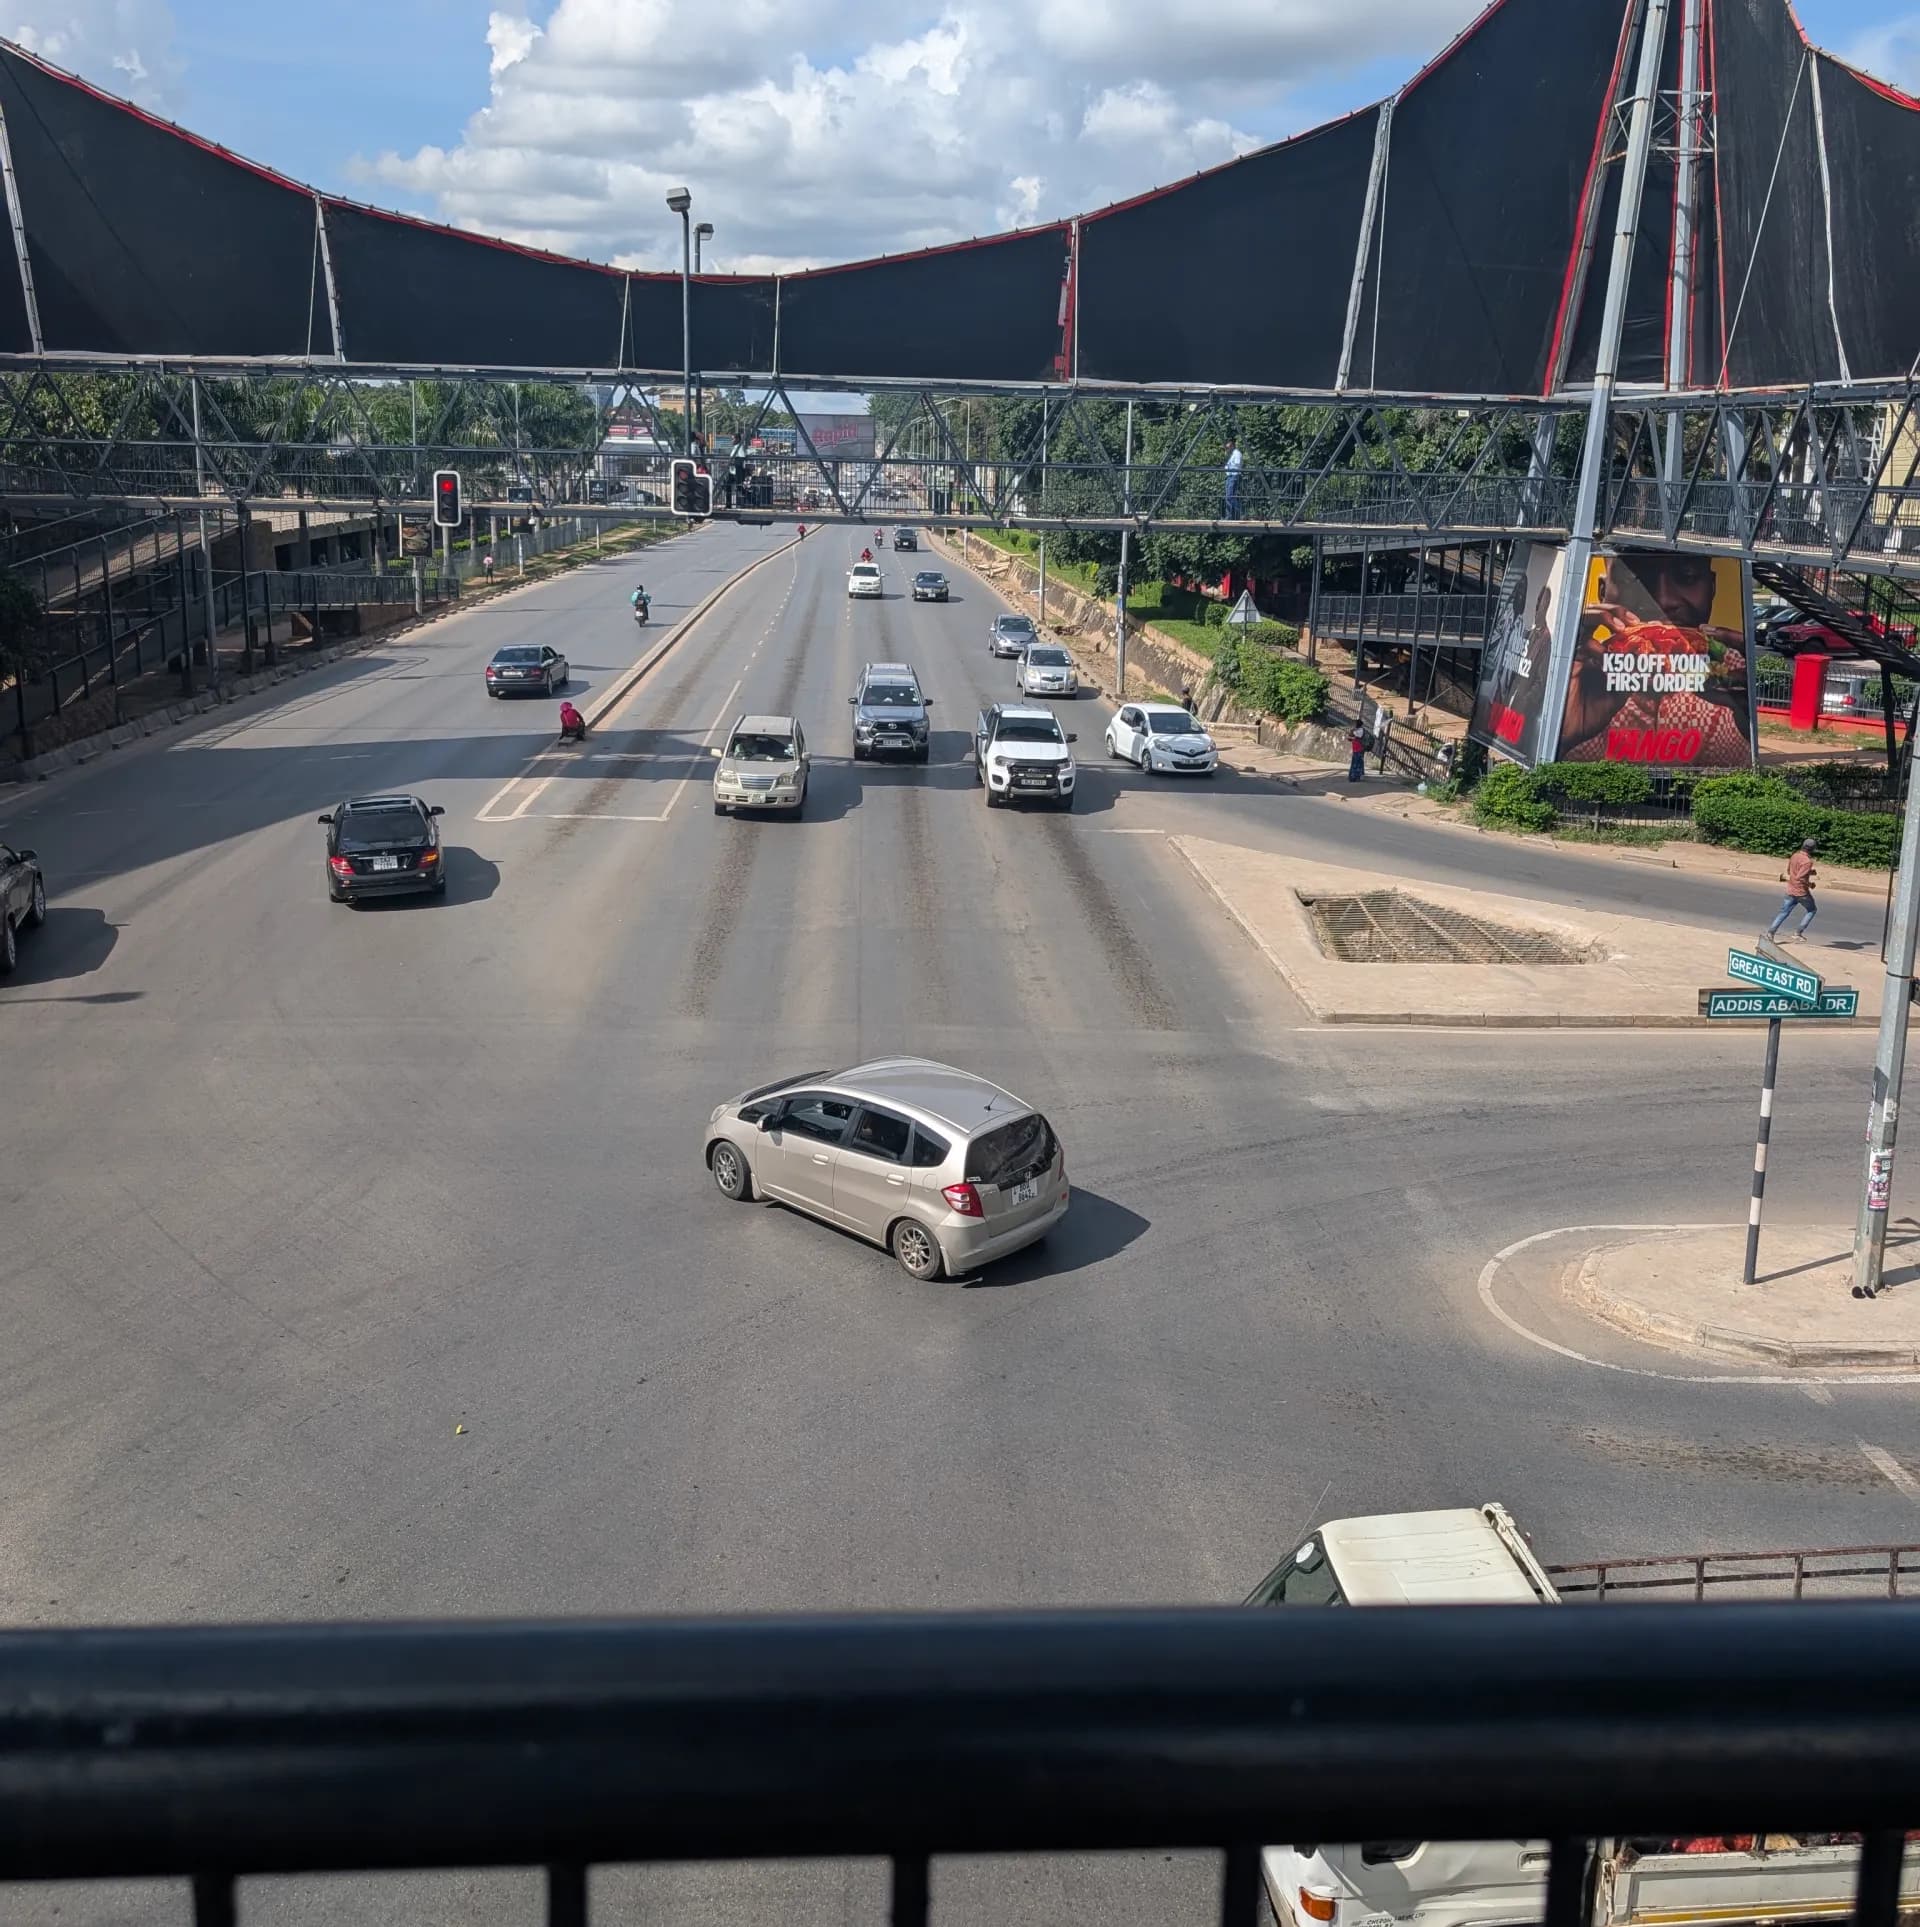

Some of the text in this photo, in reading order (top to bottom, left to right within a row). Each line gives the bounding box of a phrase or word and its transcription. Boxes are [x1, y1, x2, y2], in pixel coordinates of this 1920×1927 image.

[1603, 653, 1711, 673] K50 OFF YOUR
[1606, 673, 1705, 692] FIRST ORDER
[1605, 728, 1702, 763] YANGO
[1731, 957, 1815, 995] GREAT EAST RD.
[1714, 1000, 1763, 1012] ADDIS
[1826, 998, 1851, 1010] DR.
